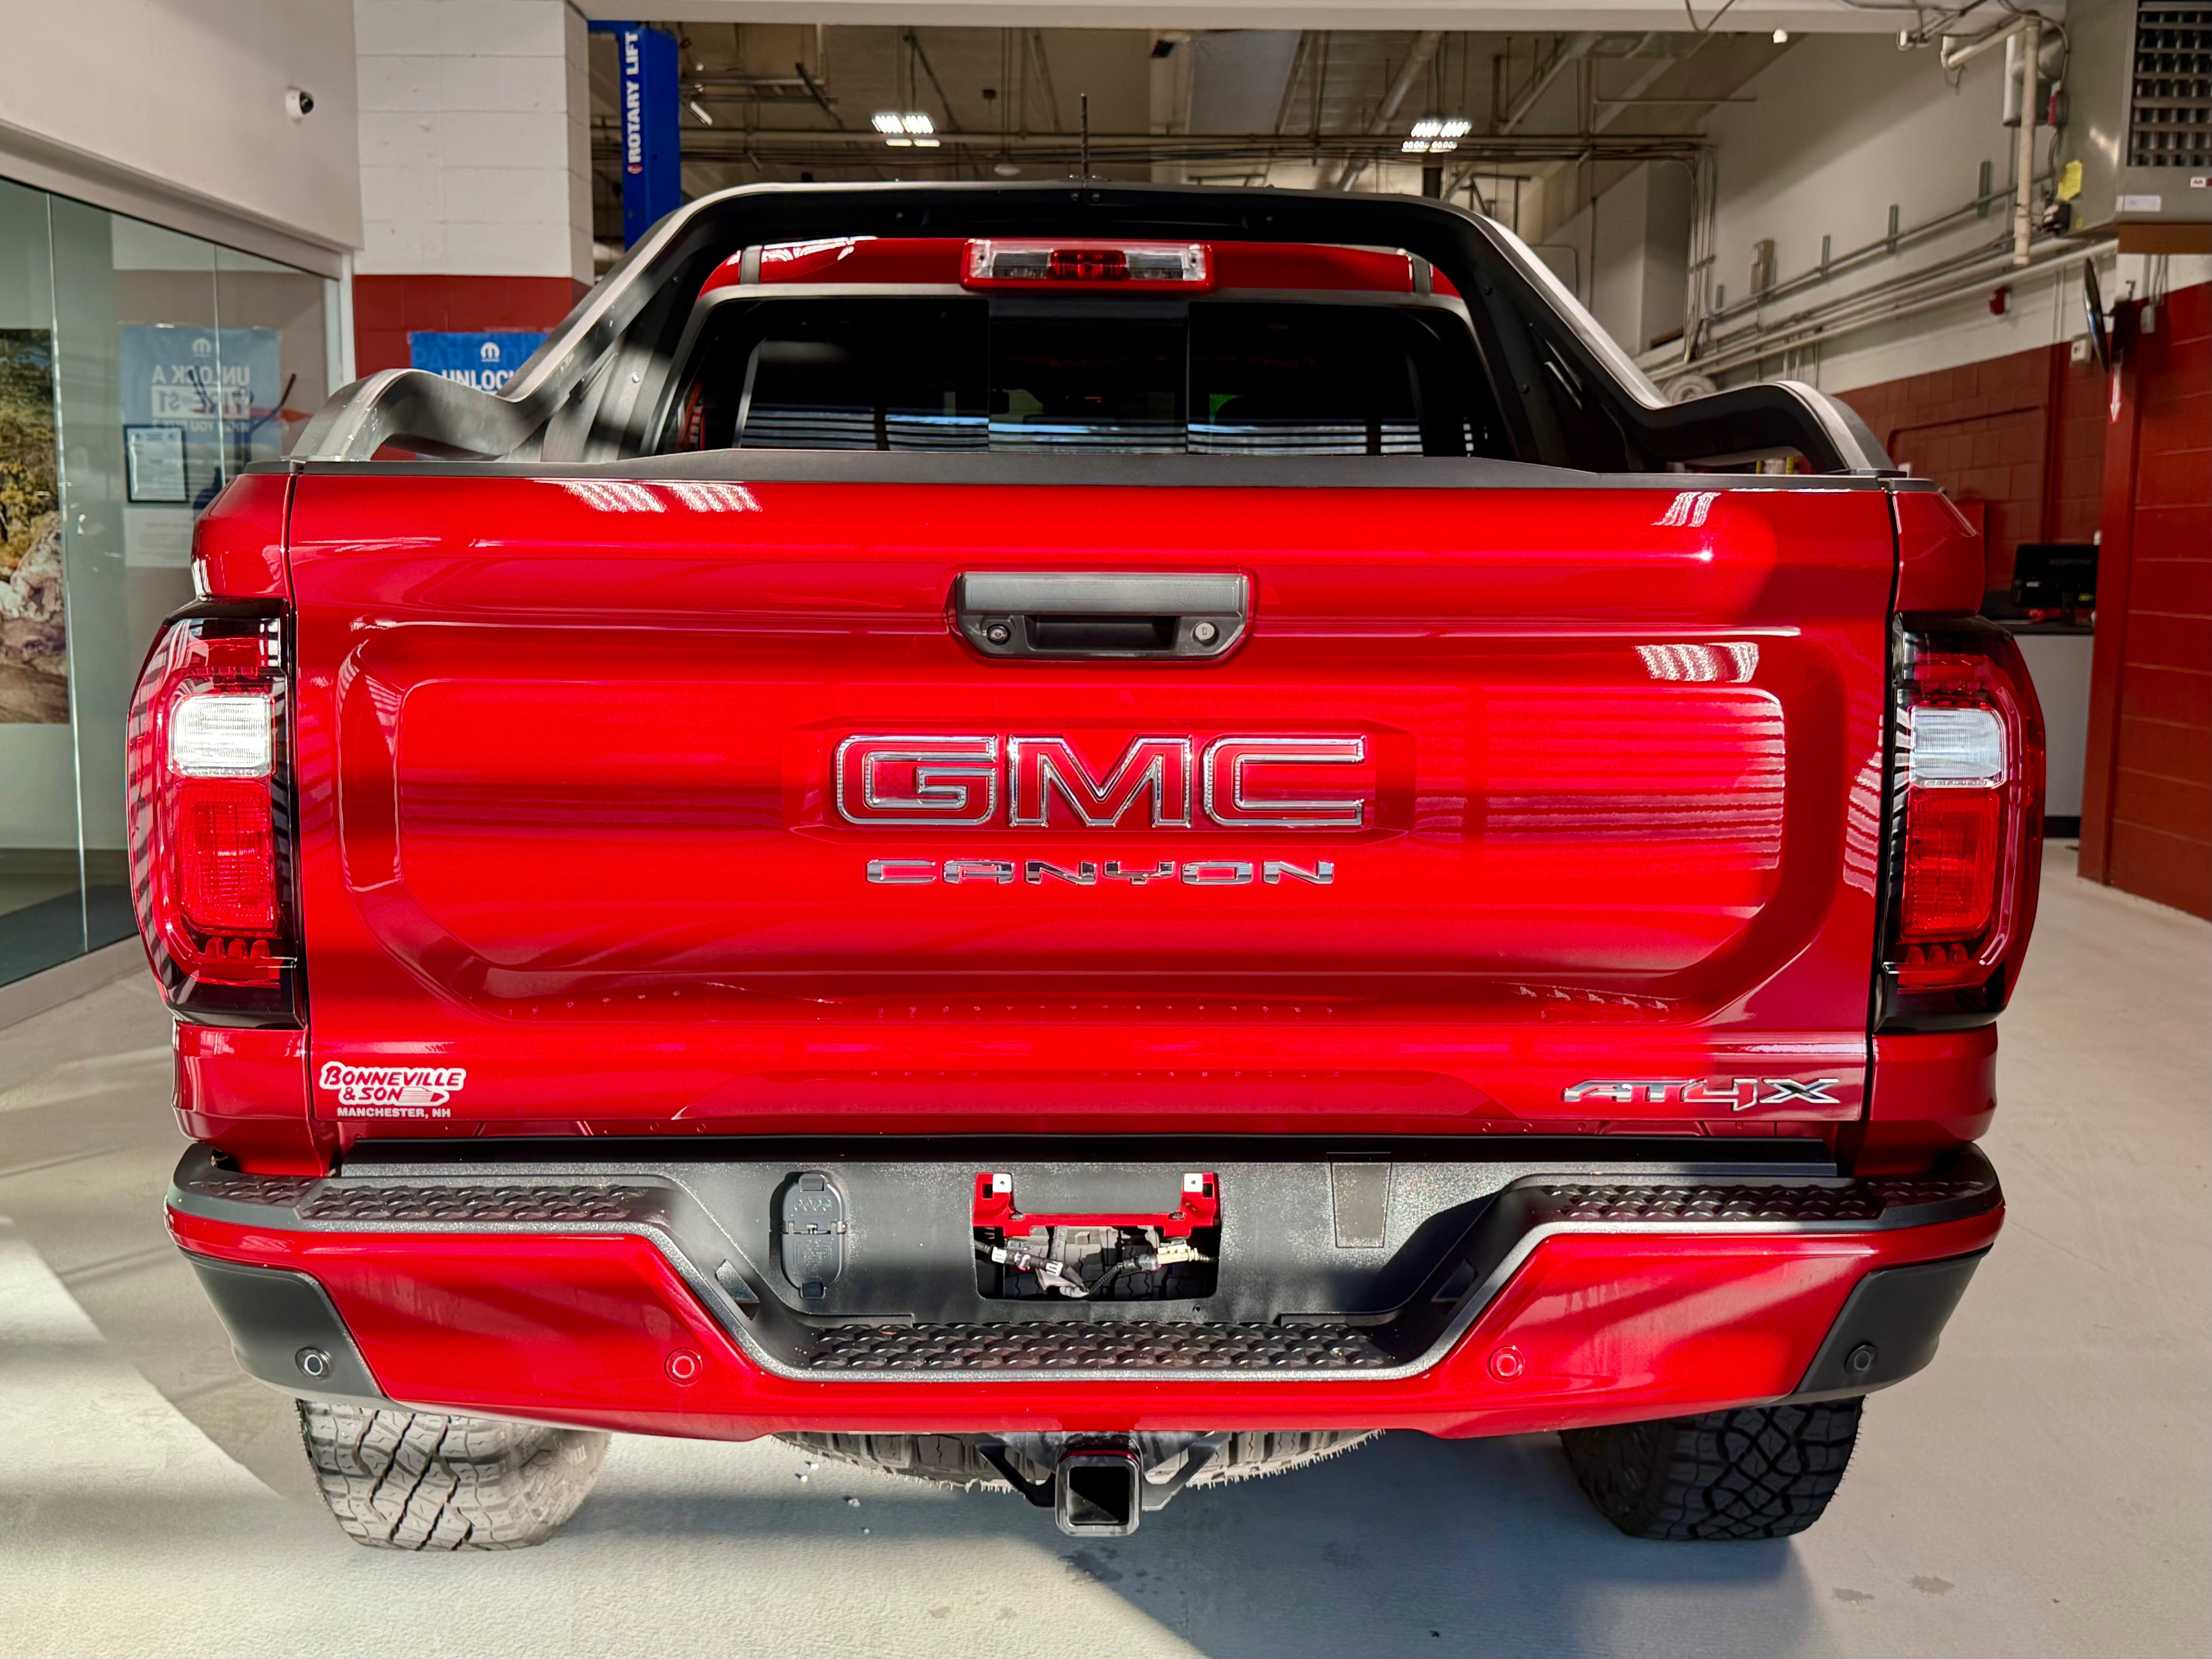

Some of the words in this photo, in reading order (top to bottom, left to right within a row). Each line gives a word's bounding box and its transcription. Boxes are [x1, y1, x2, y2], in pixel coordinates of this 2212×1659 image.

[625, 31, 639, 75] LIFT
[626, 80, 641, 164] ROTARY
[834, 734, 1365, 827] GMC
[867, 860, 1334, 886] CANYON
[323, 1064, 463, 1087] BONNEVILLE
[343, 1087, 356, 1101] &
[358, 1087, 403, 1101] SON
[1561, 1078, 1840, 1111] AT4X
[337, 1107, 428, 1119] MANCHESTER,
[432, 1108, 451, 1118] NH
